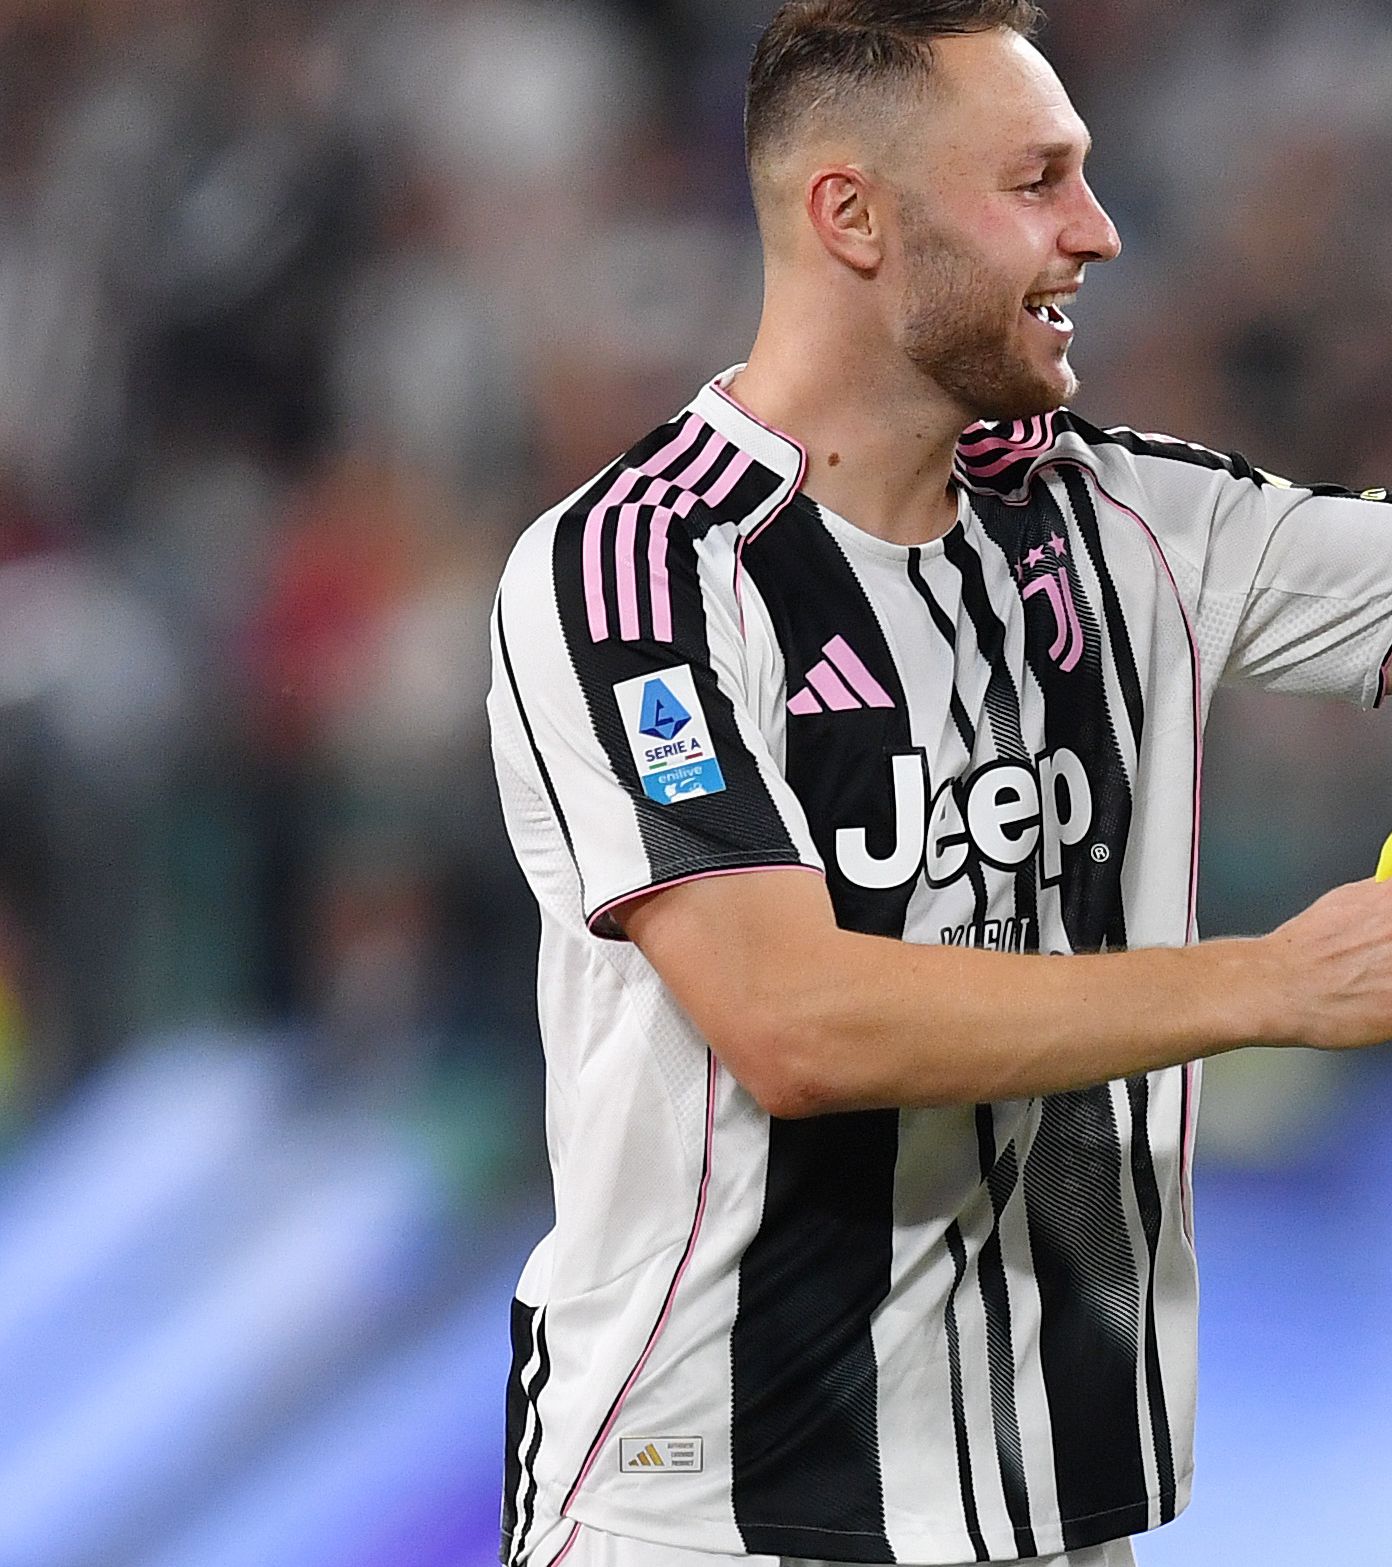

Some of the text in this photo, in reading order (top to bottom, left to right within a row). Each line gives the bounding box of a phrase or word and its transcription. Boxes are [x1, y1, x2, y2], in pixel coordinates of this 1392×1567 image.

[645, 737, 702, 762] SERIE A
[658, 766, 703, 784] enilive
[836, 748, 1093, 889] Jeep
